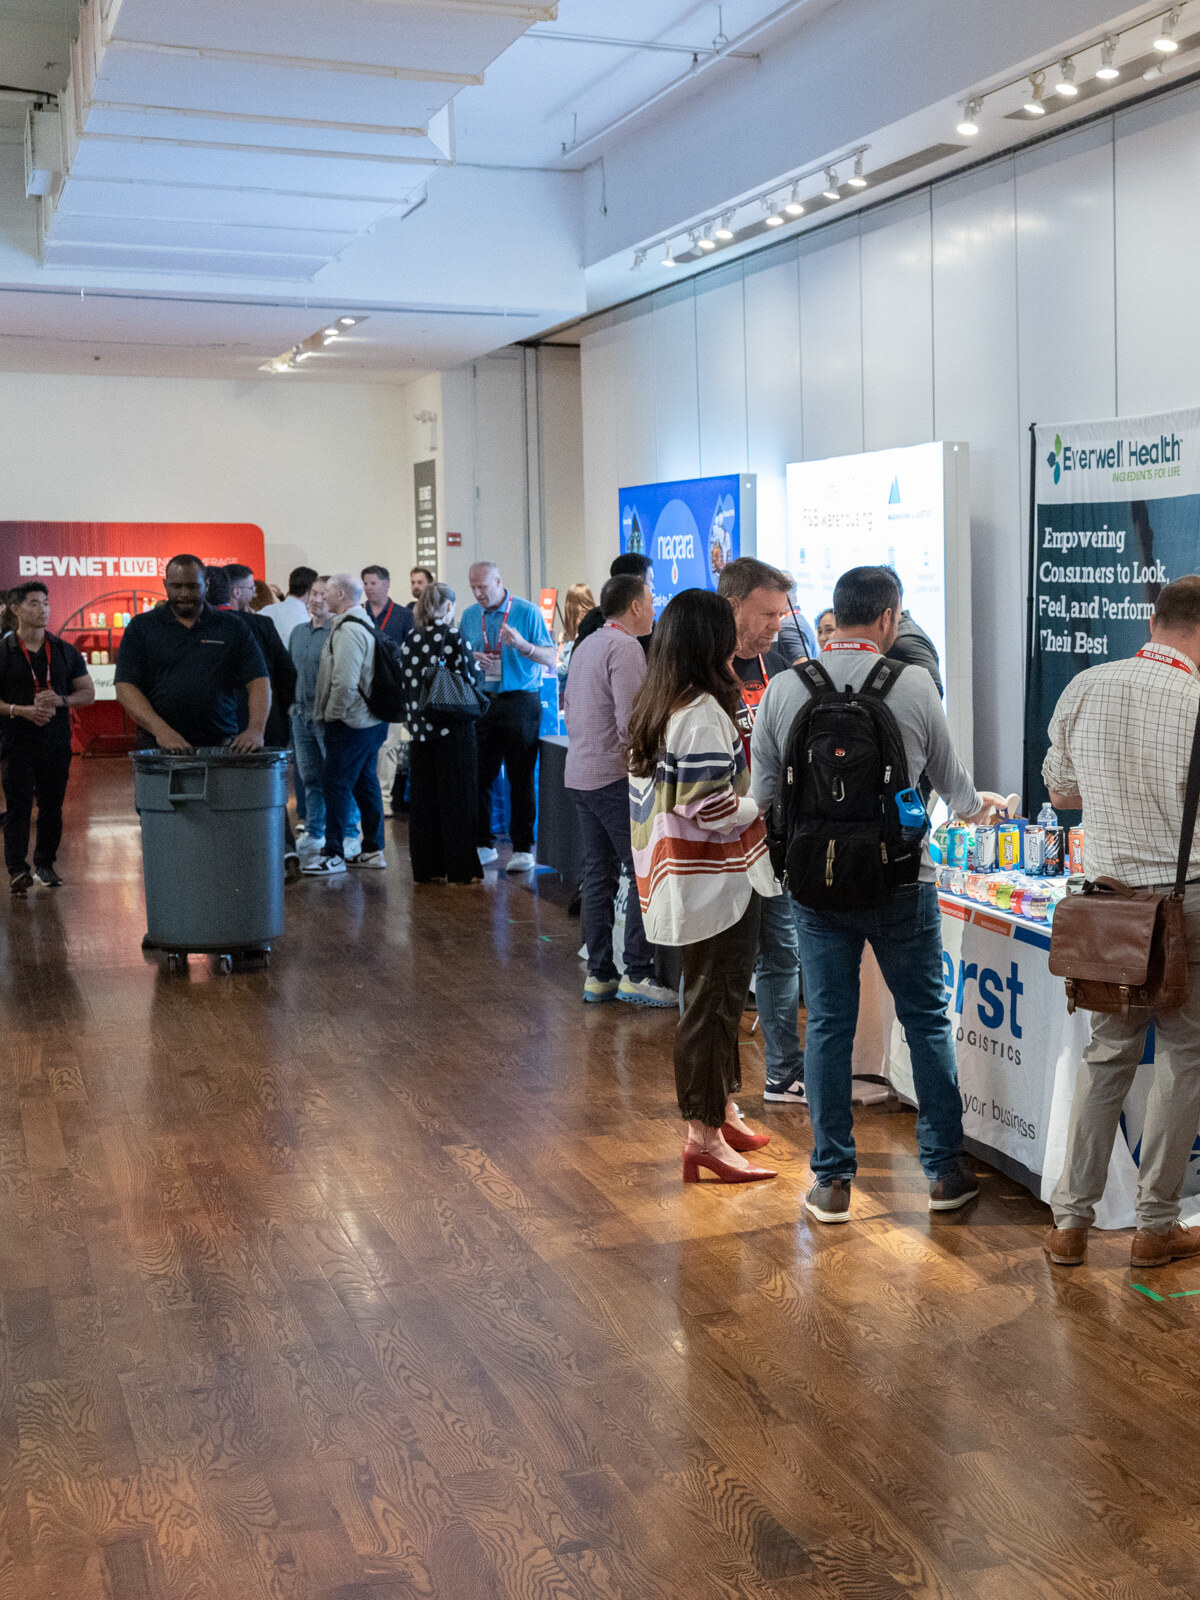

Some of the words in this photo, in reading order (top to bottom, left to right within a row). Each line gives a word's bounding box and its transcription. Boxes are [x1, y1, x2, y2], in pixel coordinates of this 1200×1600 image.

[1063, 440, 1123, 471] Everwell
[1112, 470, 1153, 482] INGREDIENTS
[1167, 466, 1180, 477] LIFE
[658, 534, 694, 570] niagara
[1043, 525, 1126, 553] Empowering
[121, 558, 156, 576] LIVE
[1039, 561, 1115, 583] Consumers
[1117, 563, 1130, 583] to
[1133, 559, 1170, 584] Look,
[1071, 596, 1100, 619] and
[1102, 596, 1156, 620] Perform
[1041, 629, 1071, 652] Their
[1074, 632, 1108, 655] Best
[942, 951, 1023, 1039] erst
[957, 1027, 1021, 1065] OGISTICS
[963, 1093, 986, 1117] your
[992, 1099, 1036, 1140] business
